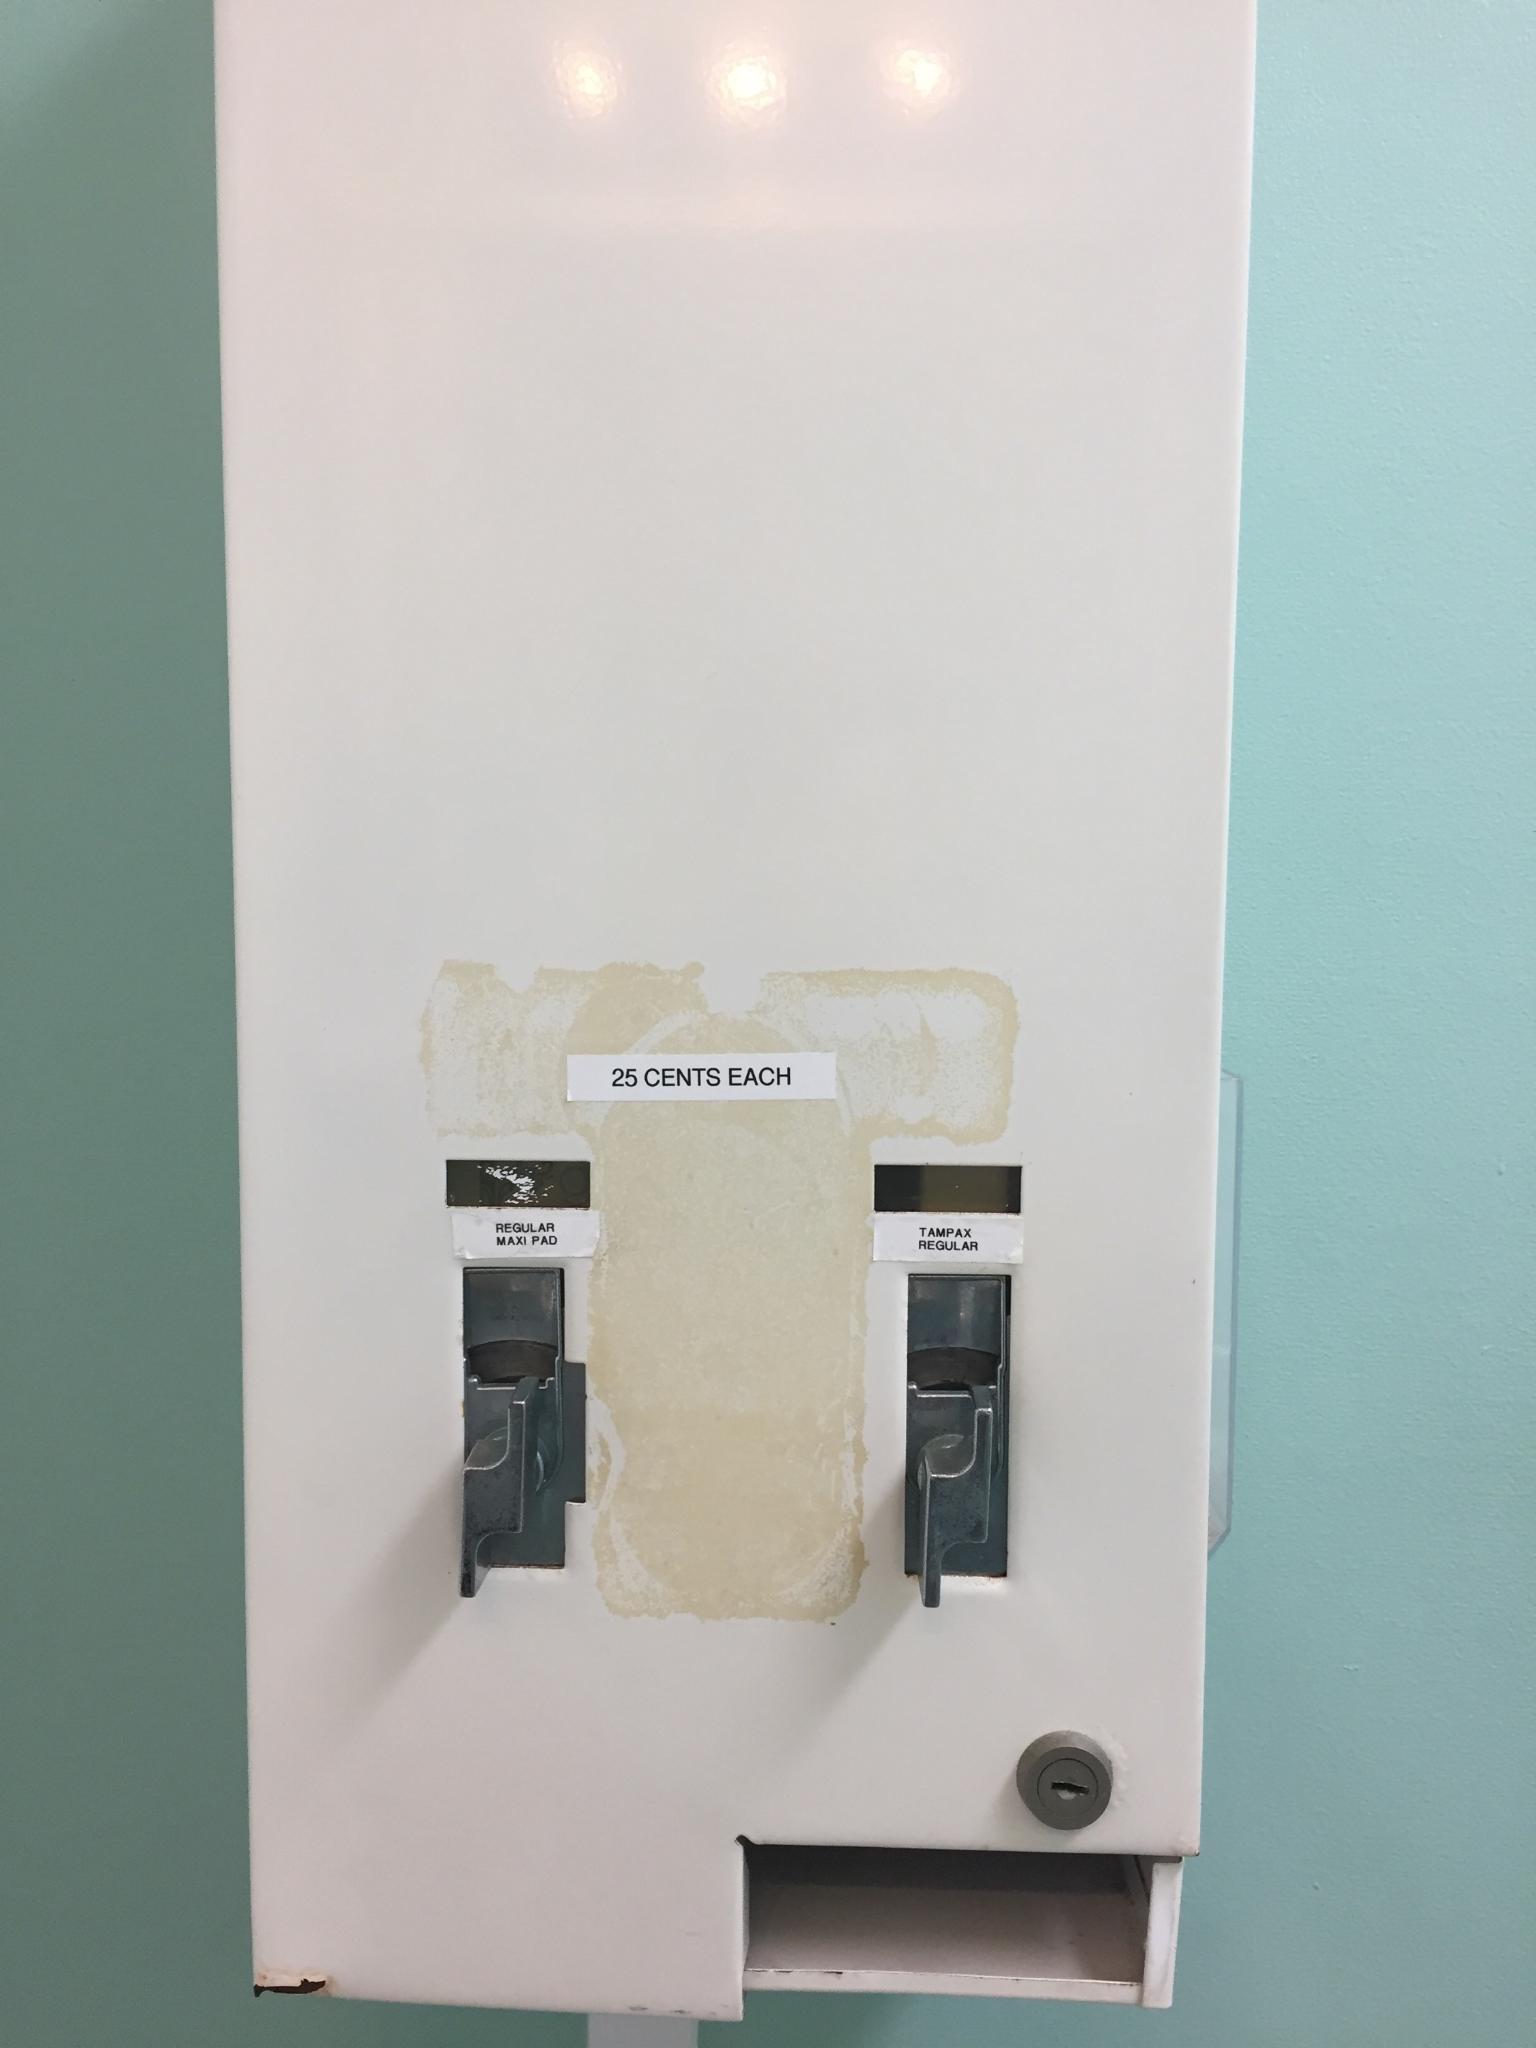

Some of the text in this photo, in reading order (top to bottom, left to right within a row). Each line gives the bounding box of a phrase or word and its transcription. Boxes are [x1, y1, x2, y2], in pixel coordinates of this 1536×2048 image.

[611, 1066, 793, 1088] 25 CENTS EACH
[495, 1222, 555, 1234] REGULAR
[918, 1227, 972, 1238] TAMPAX
[496, 1234, 558, 1246] MAXI PAD
[918, 1239, 979, 1251] REGULAR
